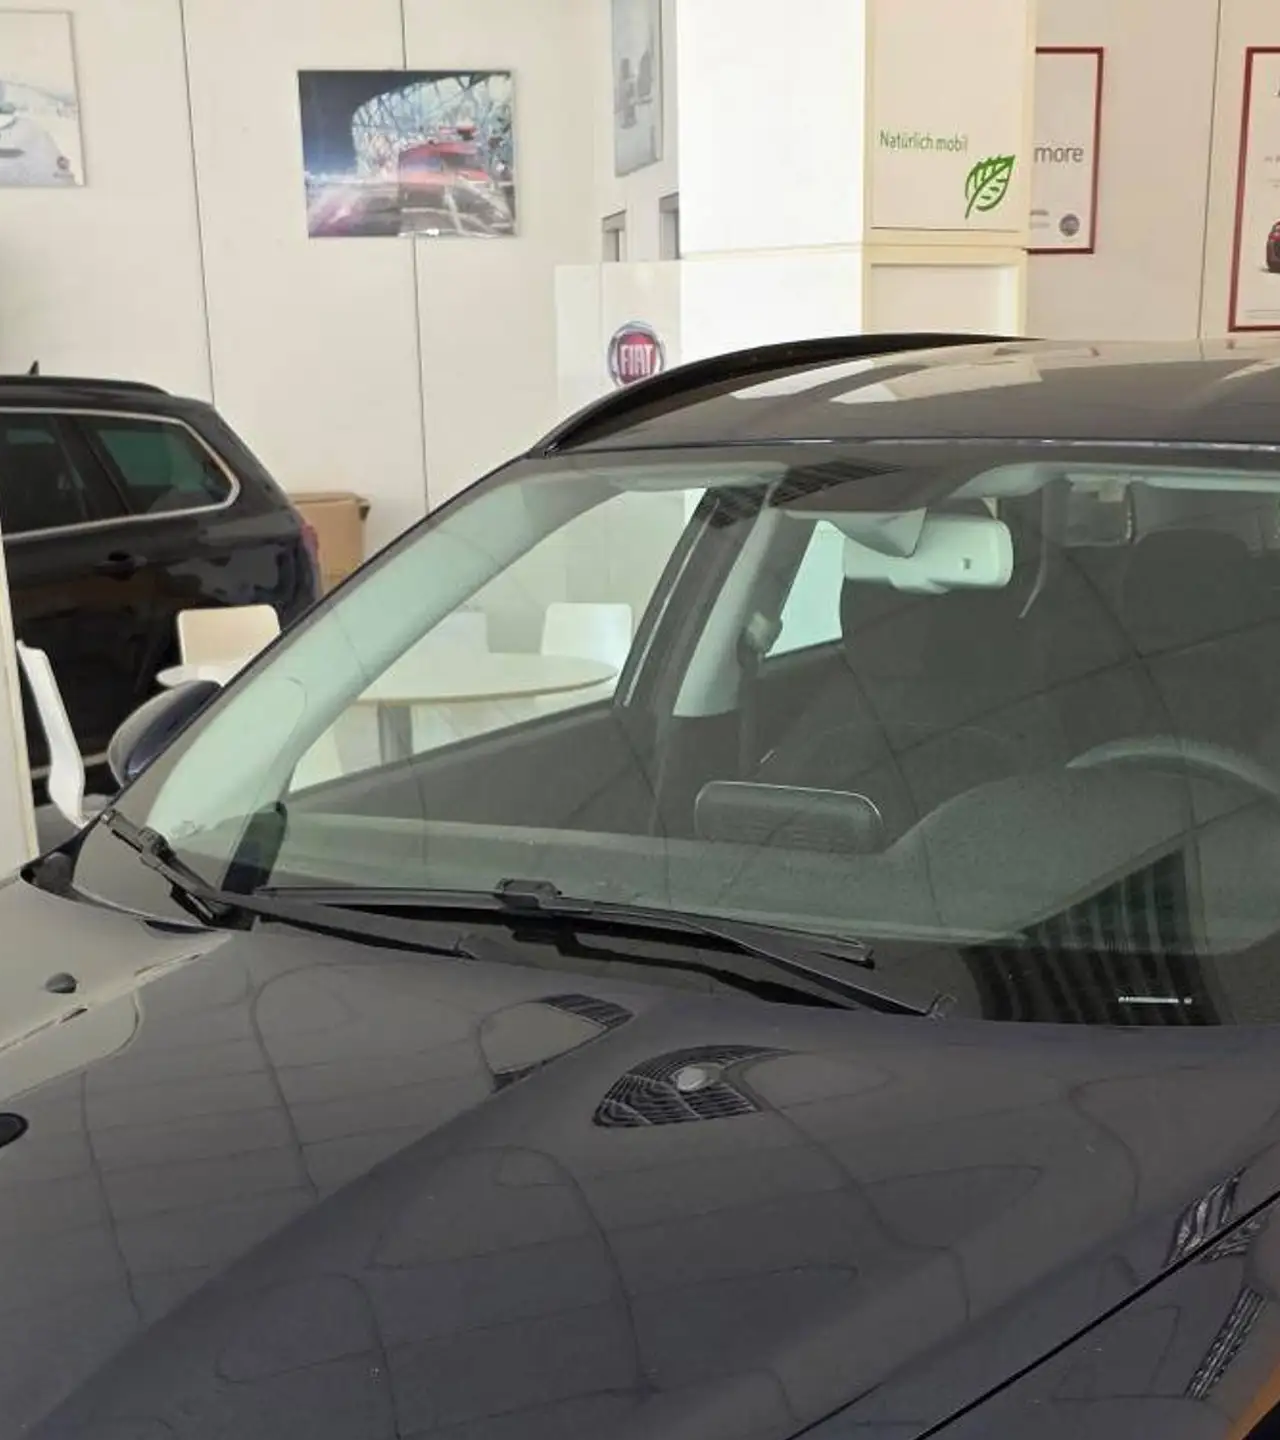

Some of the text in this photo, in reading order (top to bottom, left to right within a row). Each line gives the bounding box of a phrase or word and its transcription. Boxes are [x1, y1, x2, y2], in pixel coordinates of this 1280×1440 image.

[879, 129, 969, 152] Natürlich mobil
[1033, 145, 1084, 163] more
[620, 343, 654, 377] FIAT
